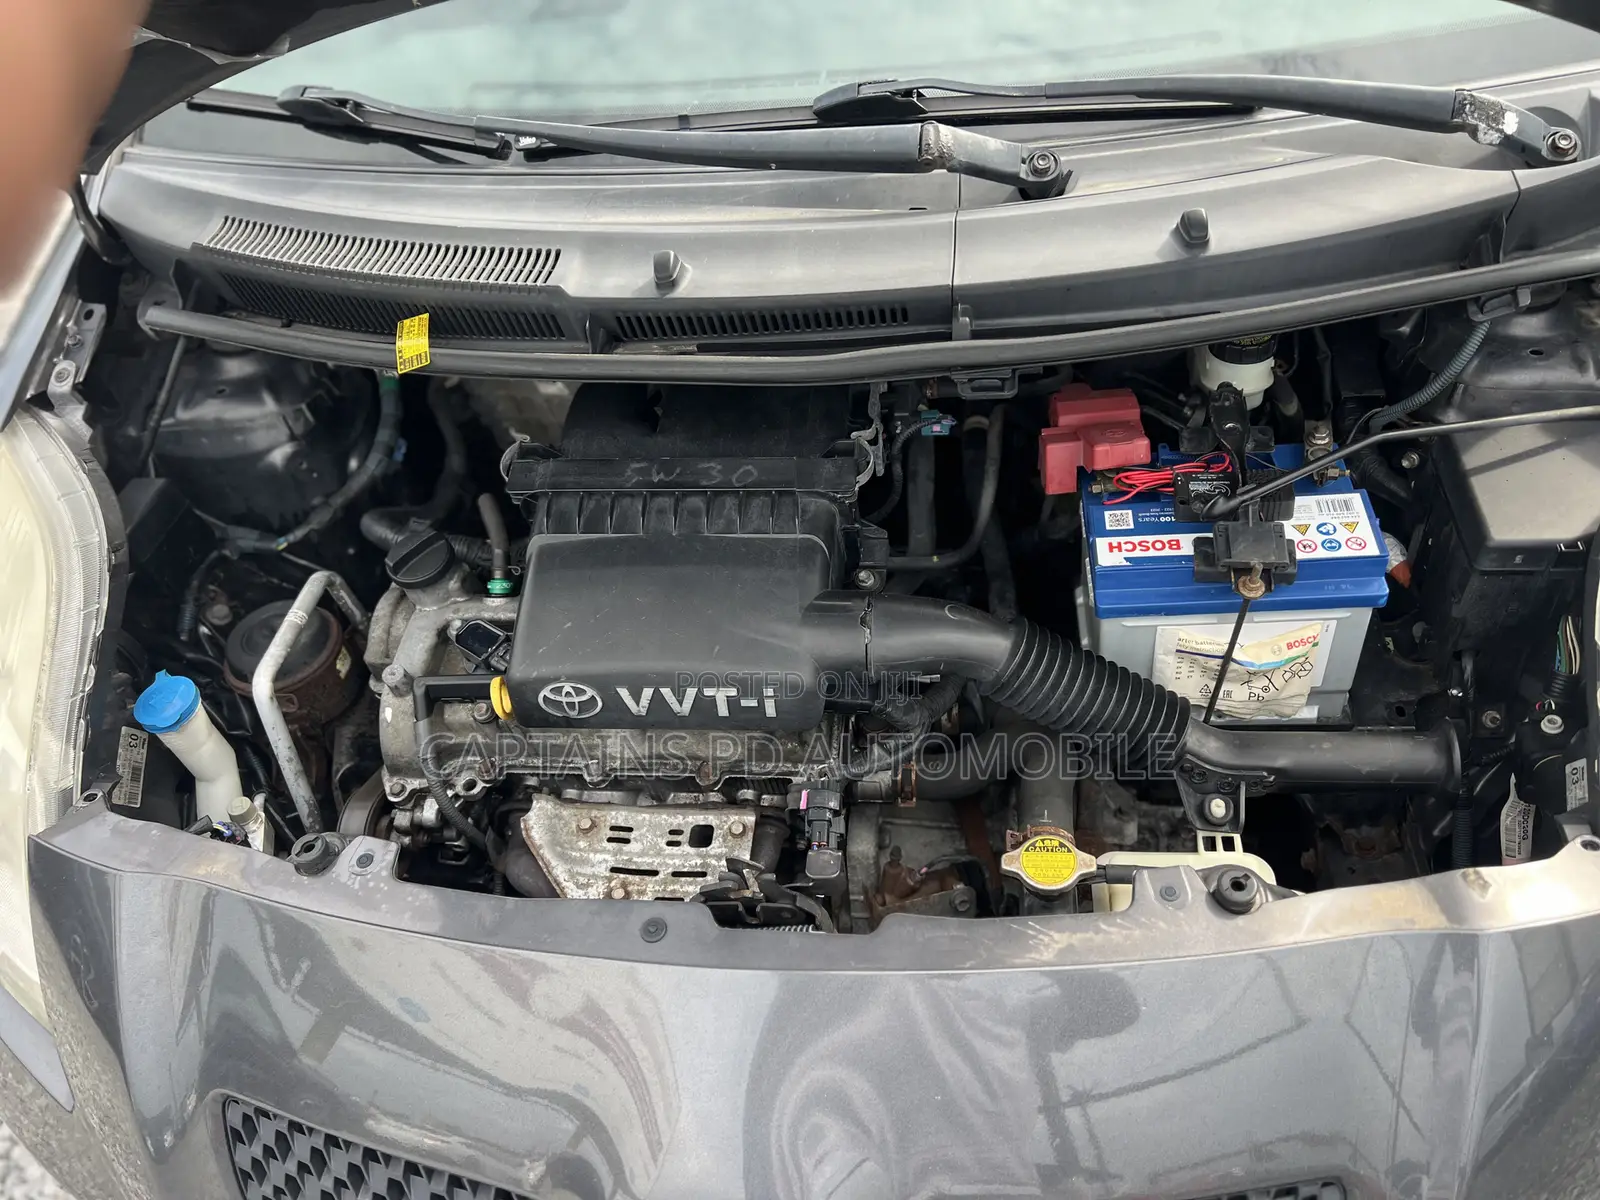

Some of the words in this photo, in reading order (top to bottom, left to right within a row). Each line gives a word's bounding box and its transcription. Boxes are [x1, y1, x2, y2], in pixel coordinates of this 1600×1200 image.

[1108, 539, 1181, 553] BOSCH
[615, 686, 777, 718] VVT-i
[1248, 691, 1265, 701] Pb
[128, 733, 139, 749] 03
[1571, 767, 1579, 786] 03
